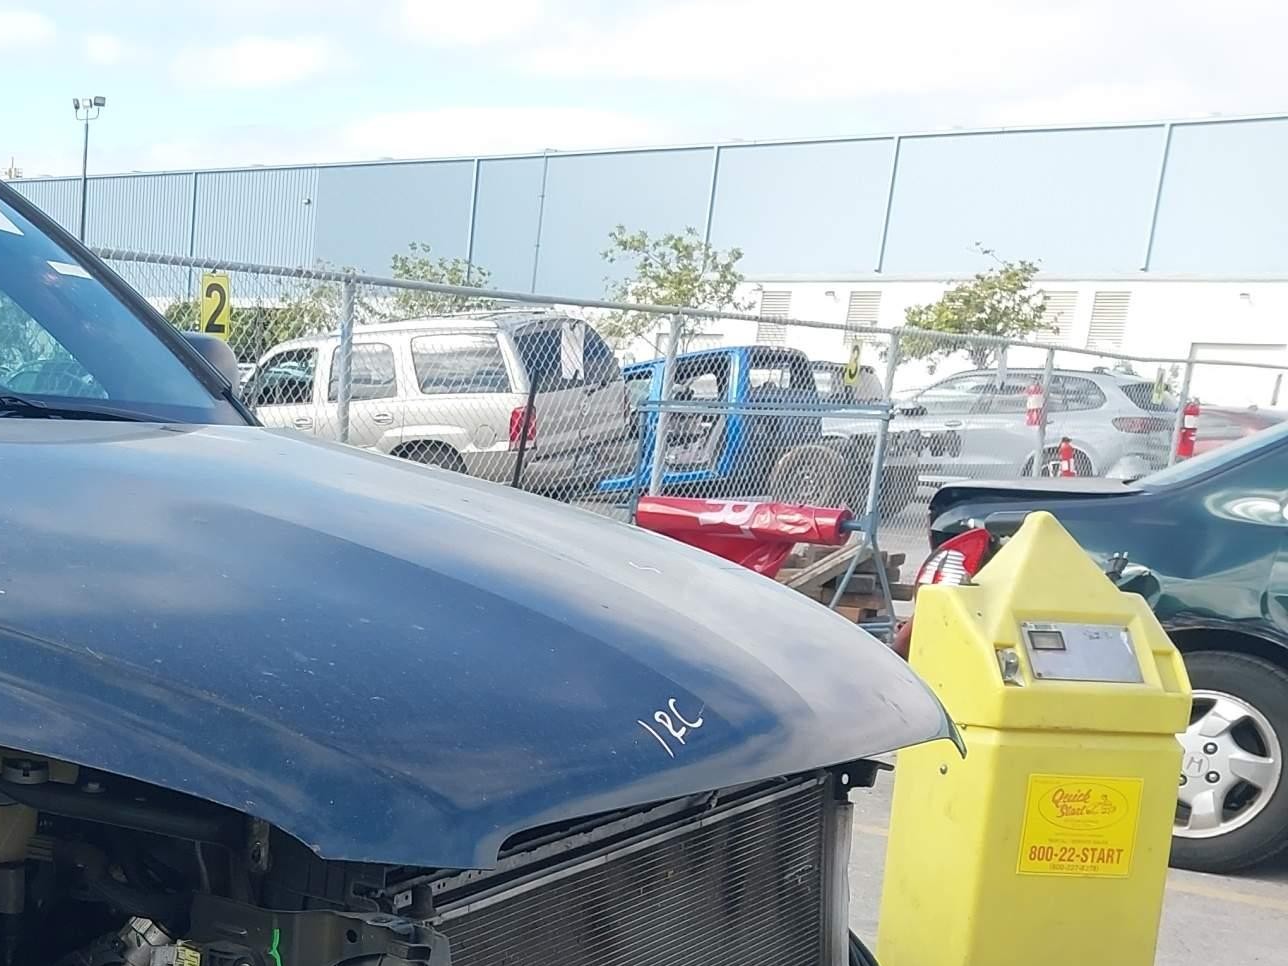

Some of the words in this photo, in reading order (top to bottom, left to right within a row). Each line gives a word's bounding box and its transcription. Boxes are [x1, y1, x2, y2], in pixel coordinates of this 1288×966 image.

[205, 283, 226, 333] 2
[849, 344, 860, 379] 3
[1052, 788, 1093, 808] Quick
[1056, 804, 1087, 818] Start
[1029, 845, 1124, 864] 800-22-START
